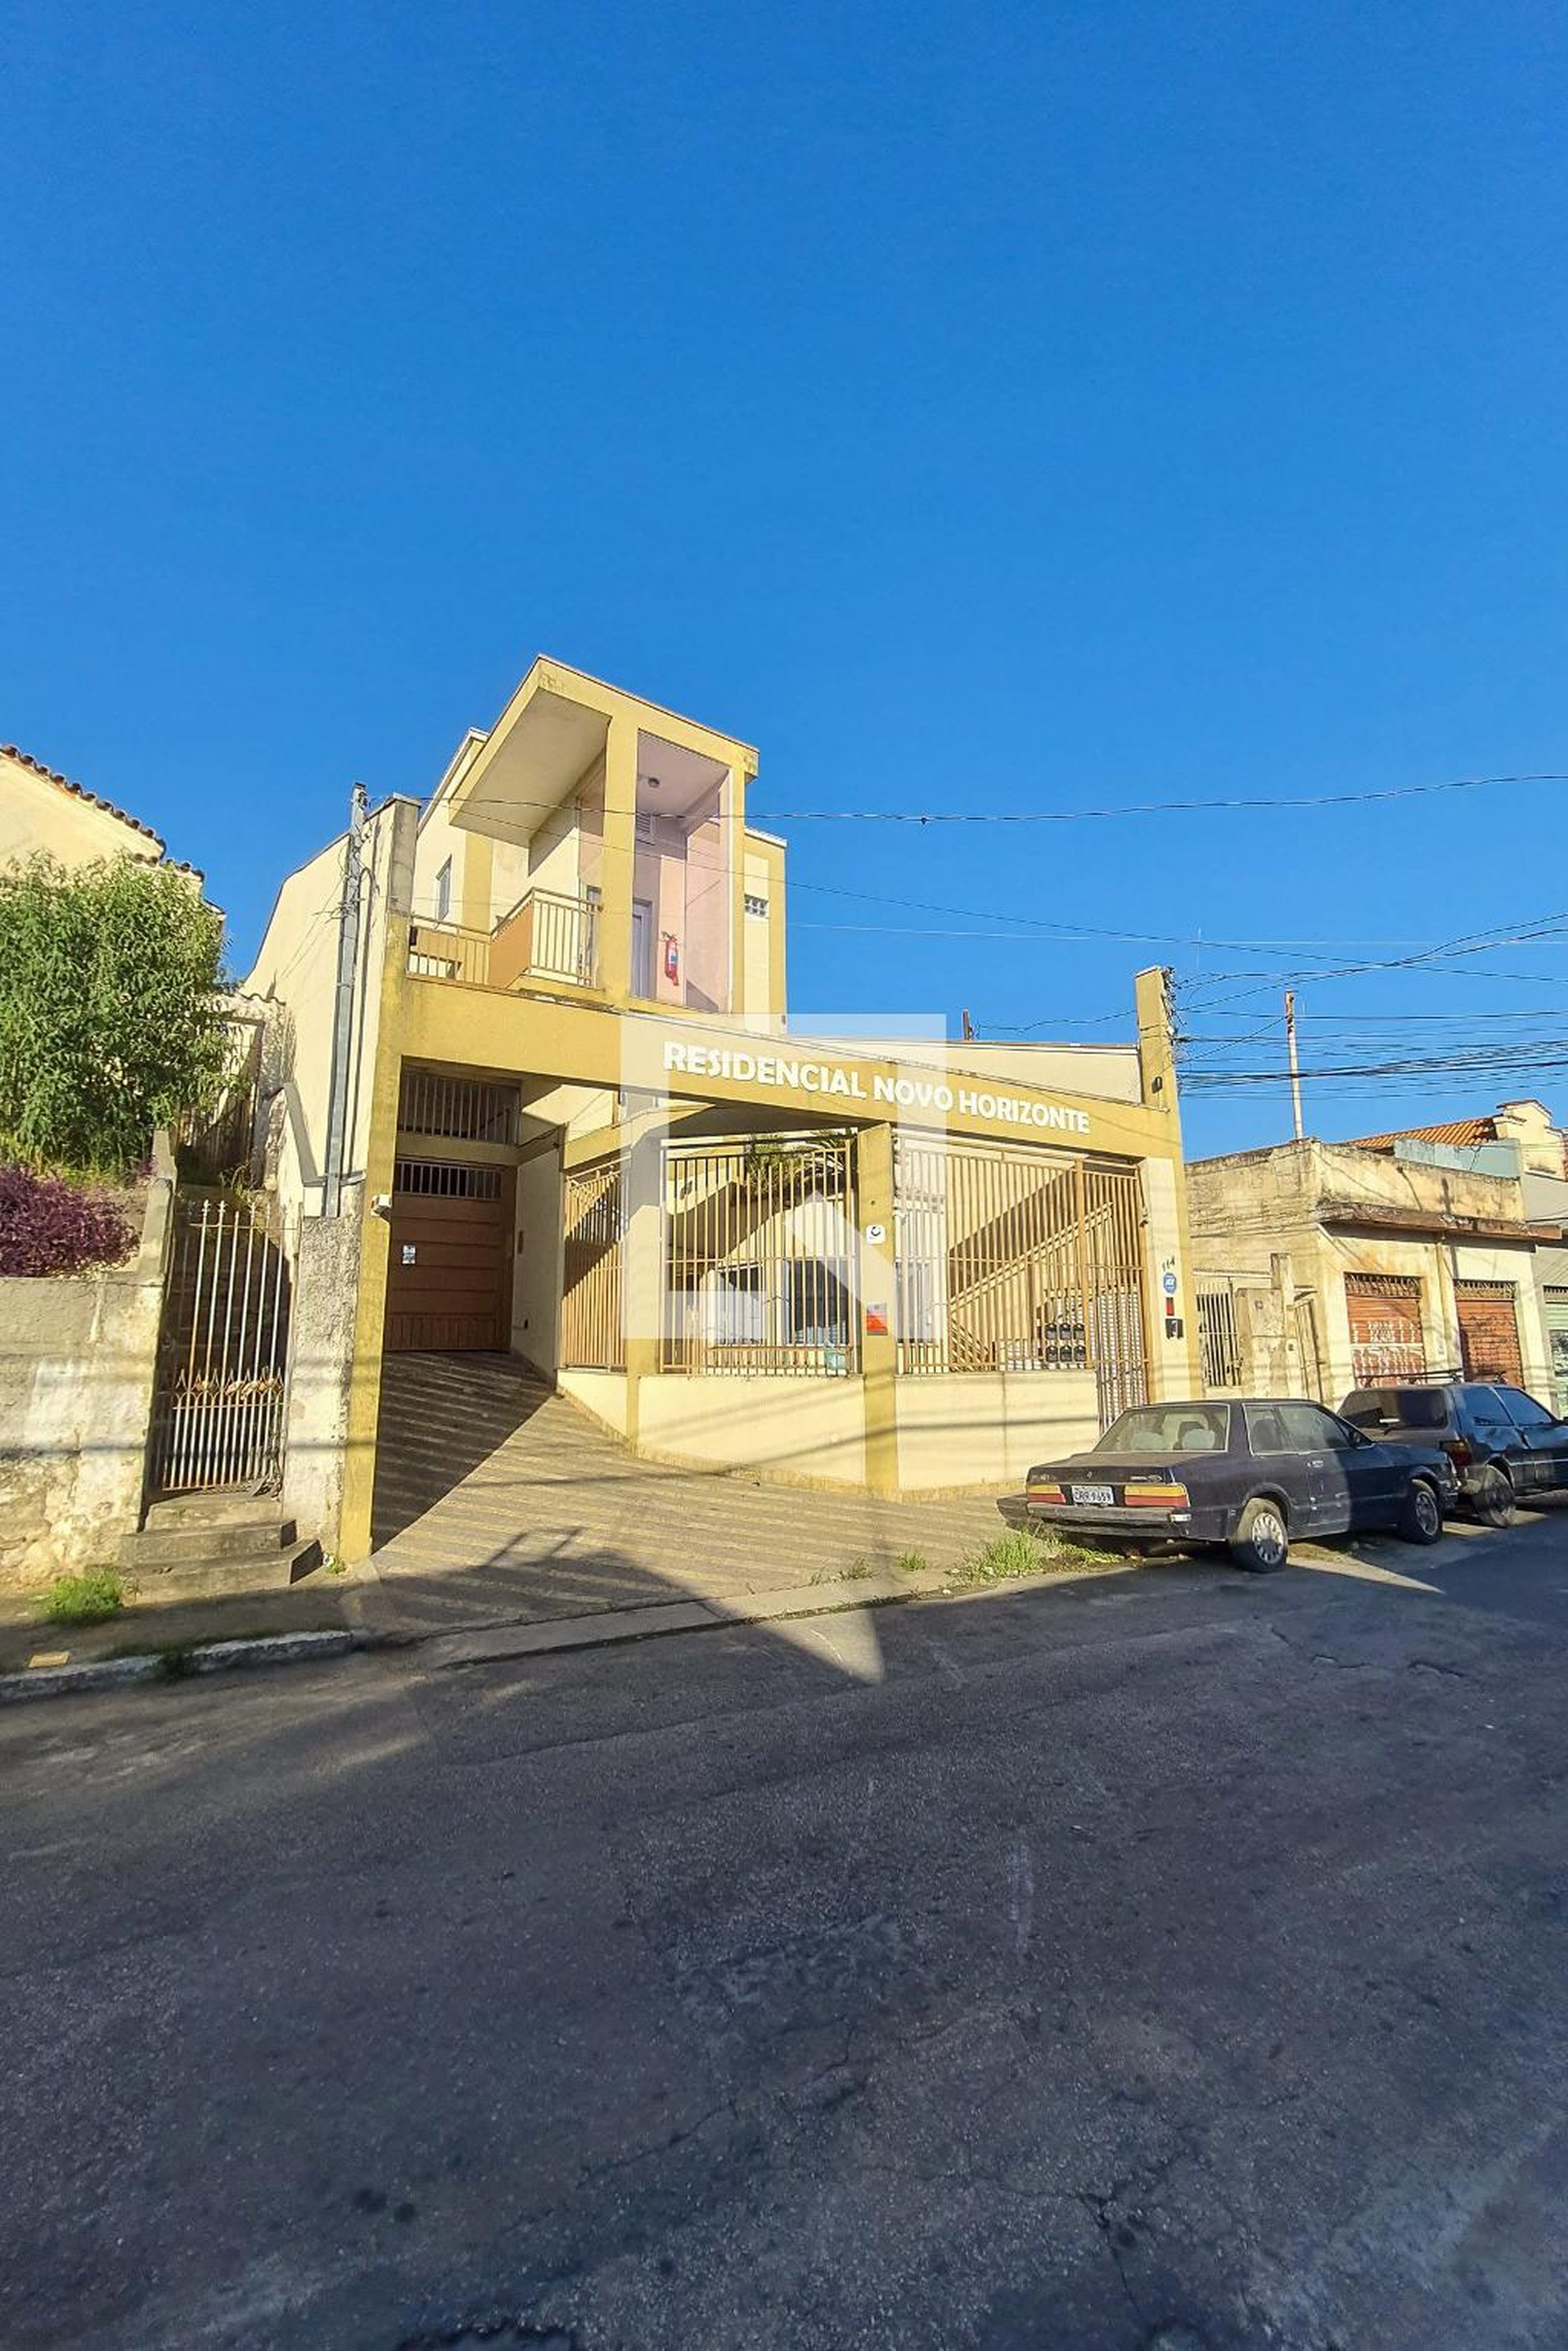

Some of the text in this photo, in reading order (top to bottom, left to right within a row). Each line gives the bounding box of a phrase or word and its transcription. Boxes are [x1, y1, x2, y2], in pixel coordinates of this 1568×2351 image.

[663, 1041, 1091, 1133] RESIDENCIAL NOVO HORIZONTE
